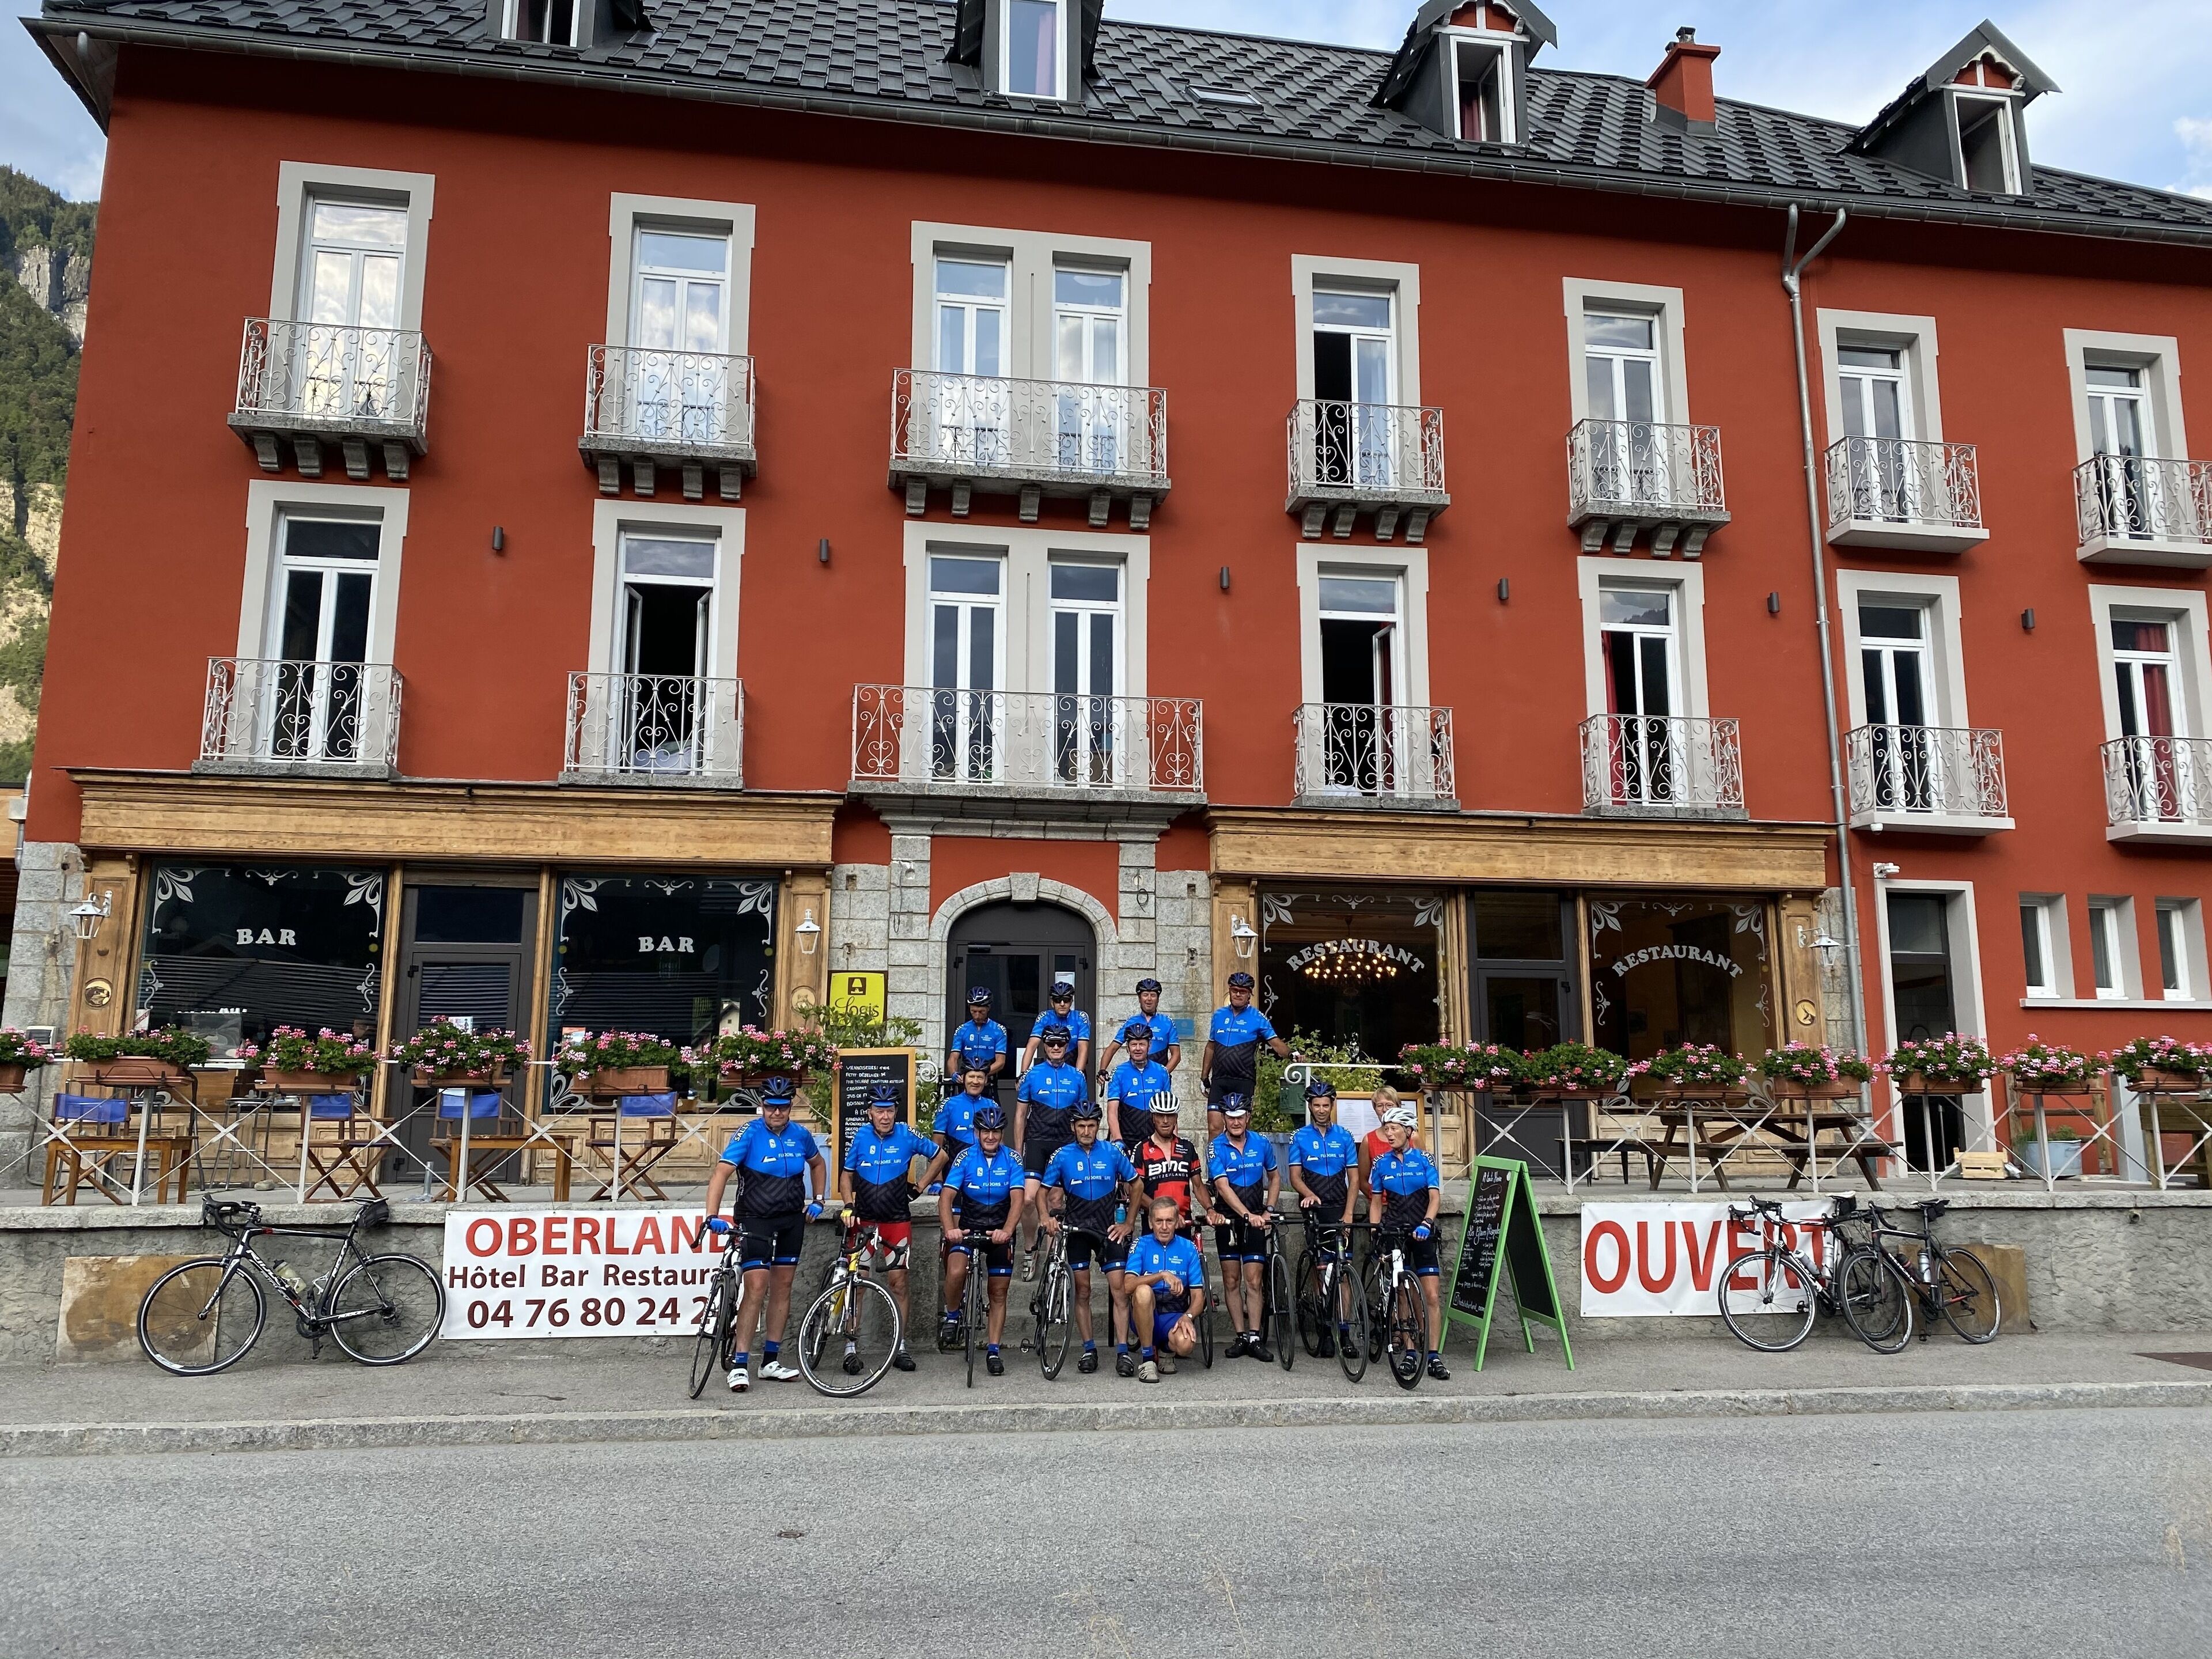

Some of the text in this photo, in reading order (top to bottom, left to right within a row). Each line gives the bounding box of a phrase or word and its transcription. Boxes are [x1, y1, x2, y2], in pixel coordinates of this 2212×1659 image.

[236, 929, 297, 946] BAR
[638, 936, 694, 953] BAR
[1286, 939, 1425, 974] RESTAURANT
[1612, 945, 1743, 978] RESTAURANT
[733, 1122, 751, 1142] SALLY
[908, 1126, 925, 1139] SALLY
[954, 1151, 969, 1167] SALLY
[1148, 1160, 1189, 1176] BMC
[1421, 1152, 1435, 1166] SALLY
[1584, 1219, 1832, 1294] OUVERT
[448, 1264, 525, 1289] Hôtel
[541, 1264, 589, 1287] Bar
[467, 1296, 710, 1328] 04 76 80 24 2
